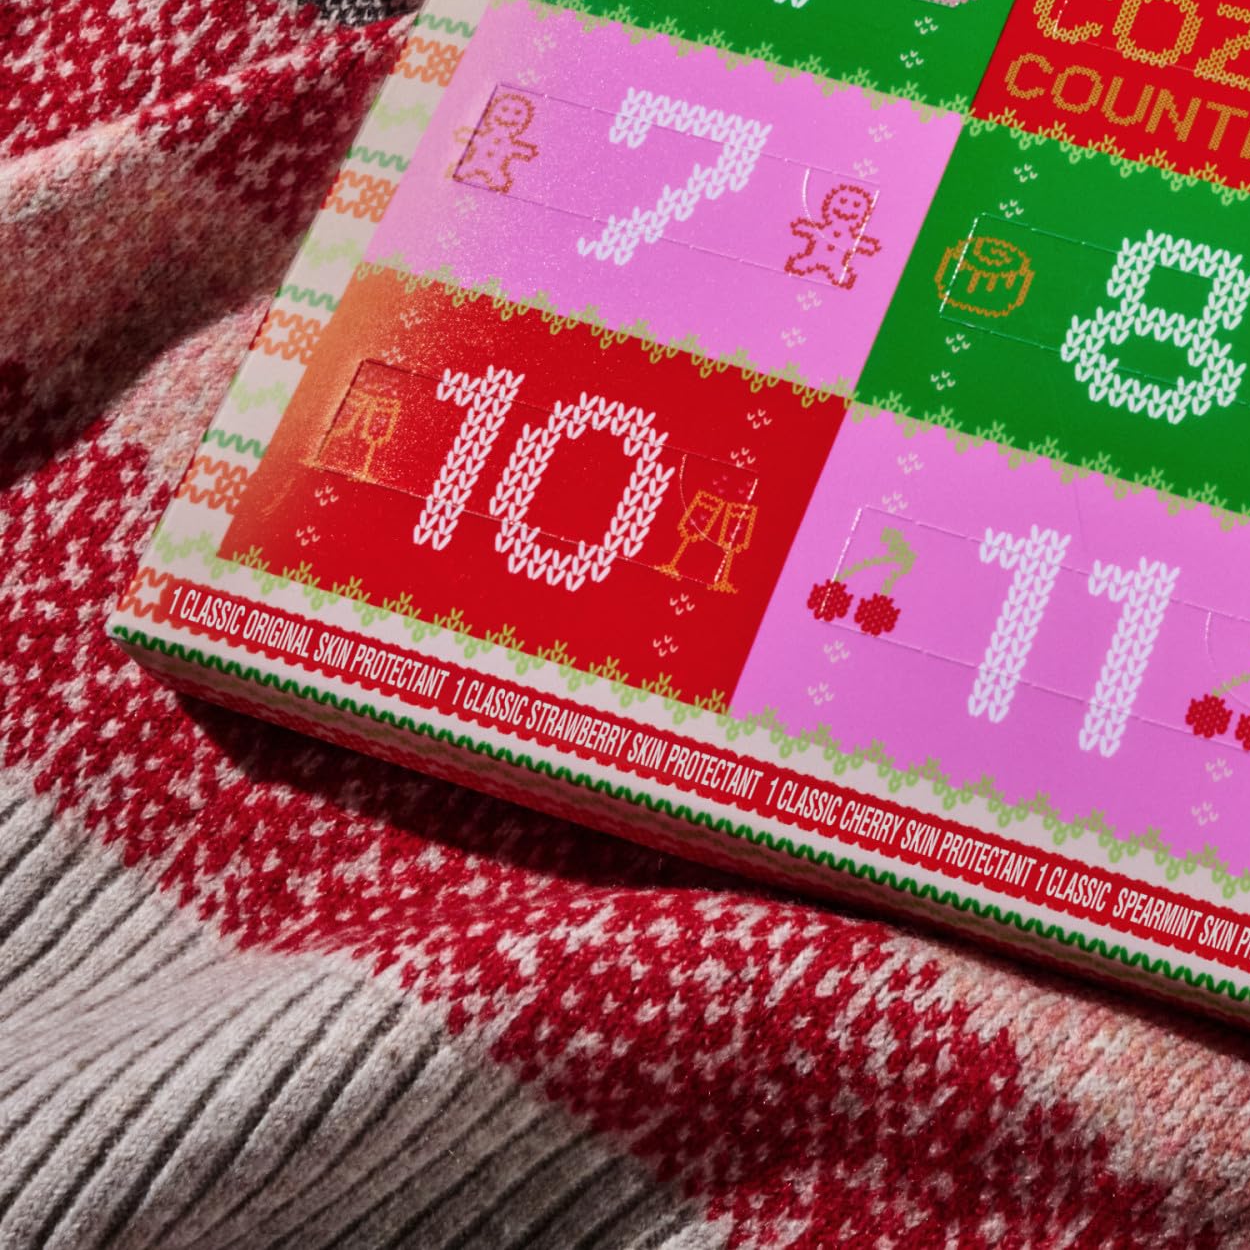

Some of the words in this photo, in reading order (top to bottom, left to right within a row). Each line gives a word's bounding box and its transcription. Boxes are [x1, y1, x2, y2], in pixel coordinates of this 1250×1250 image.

[577, 87, 772, 266] 7
[412, 365, 675, 591] 10
[967, 523, 1182, 758] 11
[169, 586, 183, 615] 1
[180, 589, 246, 634] CLASSIC
[242, 609, 315, 658] ORIGINAL
[313, 632, 352, 670] SKIN
[349, 644, 450, 700] PROTECTANT
[452, 677, 466, 706] 1
[463, 680, 529, 726] CLASSIC
[525, 699, 633, 758] STRAWBERRY
[627, 732, 663, 770] SKIN
[662, 743, 764, 801] PROTECTANT
[766, 776, 779, 806] 1
[777, 779, 843, 826] CLASSIC
[839, 800, 905, 845] CHERRY
[900, 819, 942, 858] SKIN
[936, 831, 1037, 888] PROTECTANT
[1035, 863, 1047, 892] 1
[1046, 866, 1112, 912] CLASSIC
[1112, 887, 1203, 941] SPEARMINT
[1198, 915, 1239, 952] SKIN
